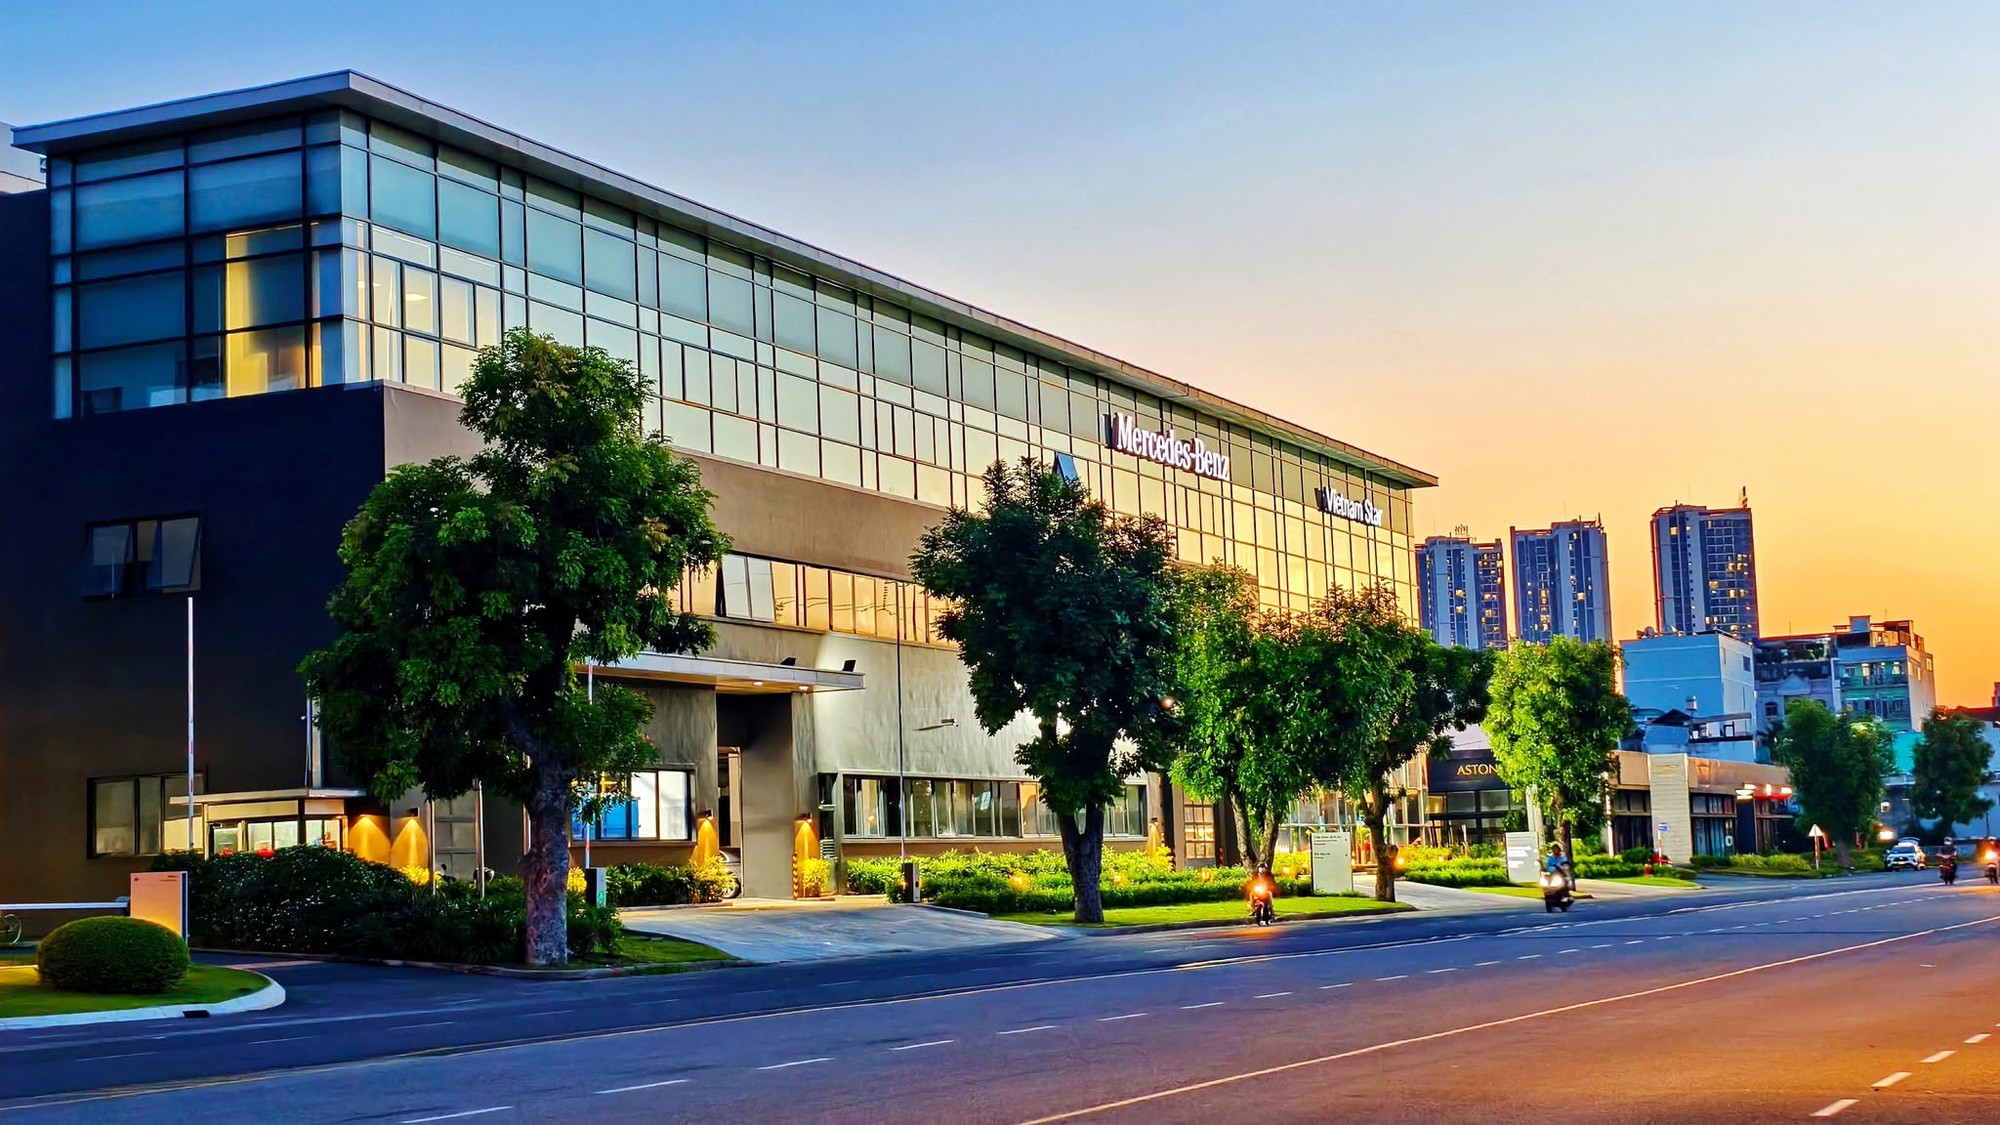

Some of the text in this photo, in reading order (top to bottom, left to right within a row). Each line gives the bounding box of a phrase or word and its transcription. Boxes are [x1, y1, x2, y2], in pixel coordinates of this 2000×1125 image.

[1117, 412, 1230, 480] Mercedes-Benz
[1325, 486, 1383, 526] Vietnam Star
[1457, 763, 1498, 776] ASTON
